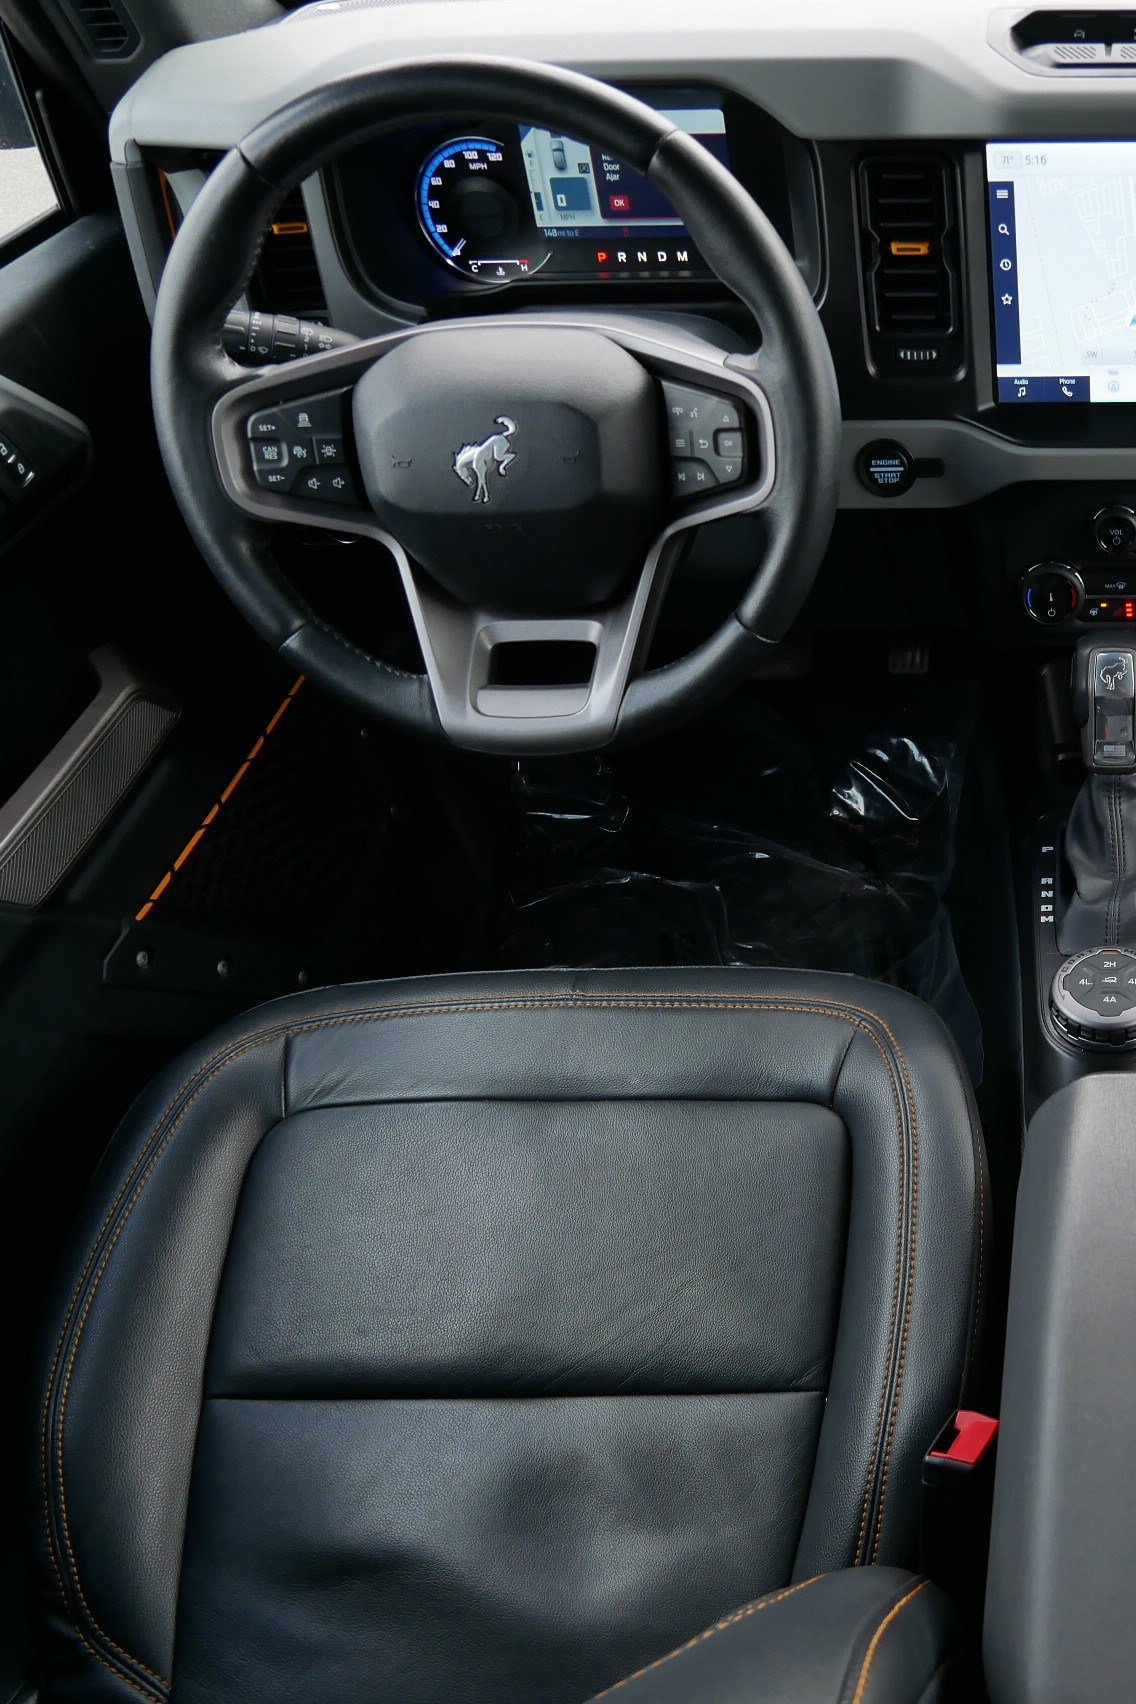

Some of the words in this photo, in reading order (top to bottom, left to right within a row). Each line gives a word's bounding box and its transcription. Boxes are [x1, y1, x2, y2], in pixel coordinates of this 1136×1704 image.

[463, 151, 478, 159] 100
[487, 153, 503, 161] 120
[444, 160, 456, 168] 80
[1002, 156, 1014, 165] 71°
[1025, 155, 1047, 166] 5:16
[603, 162, 620, 170] Door
[431, 177, 442, 186] 60
[606, 173, 620, 182] Ajar
[428, 200, 440, 208] 40
[557, 194, 567, 207] 0
[436, 225, 448, 233] 20
[544, 229, 558, 237] 148
[598, 252, 606, 262] P
[618, 252, 627, 262] R
[638, 252, 648, 262] N
[658, 252, 668, 262] D
[678, 252, 688, 262] M
